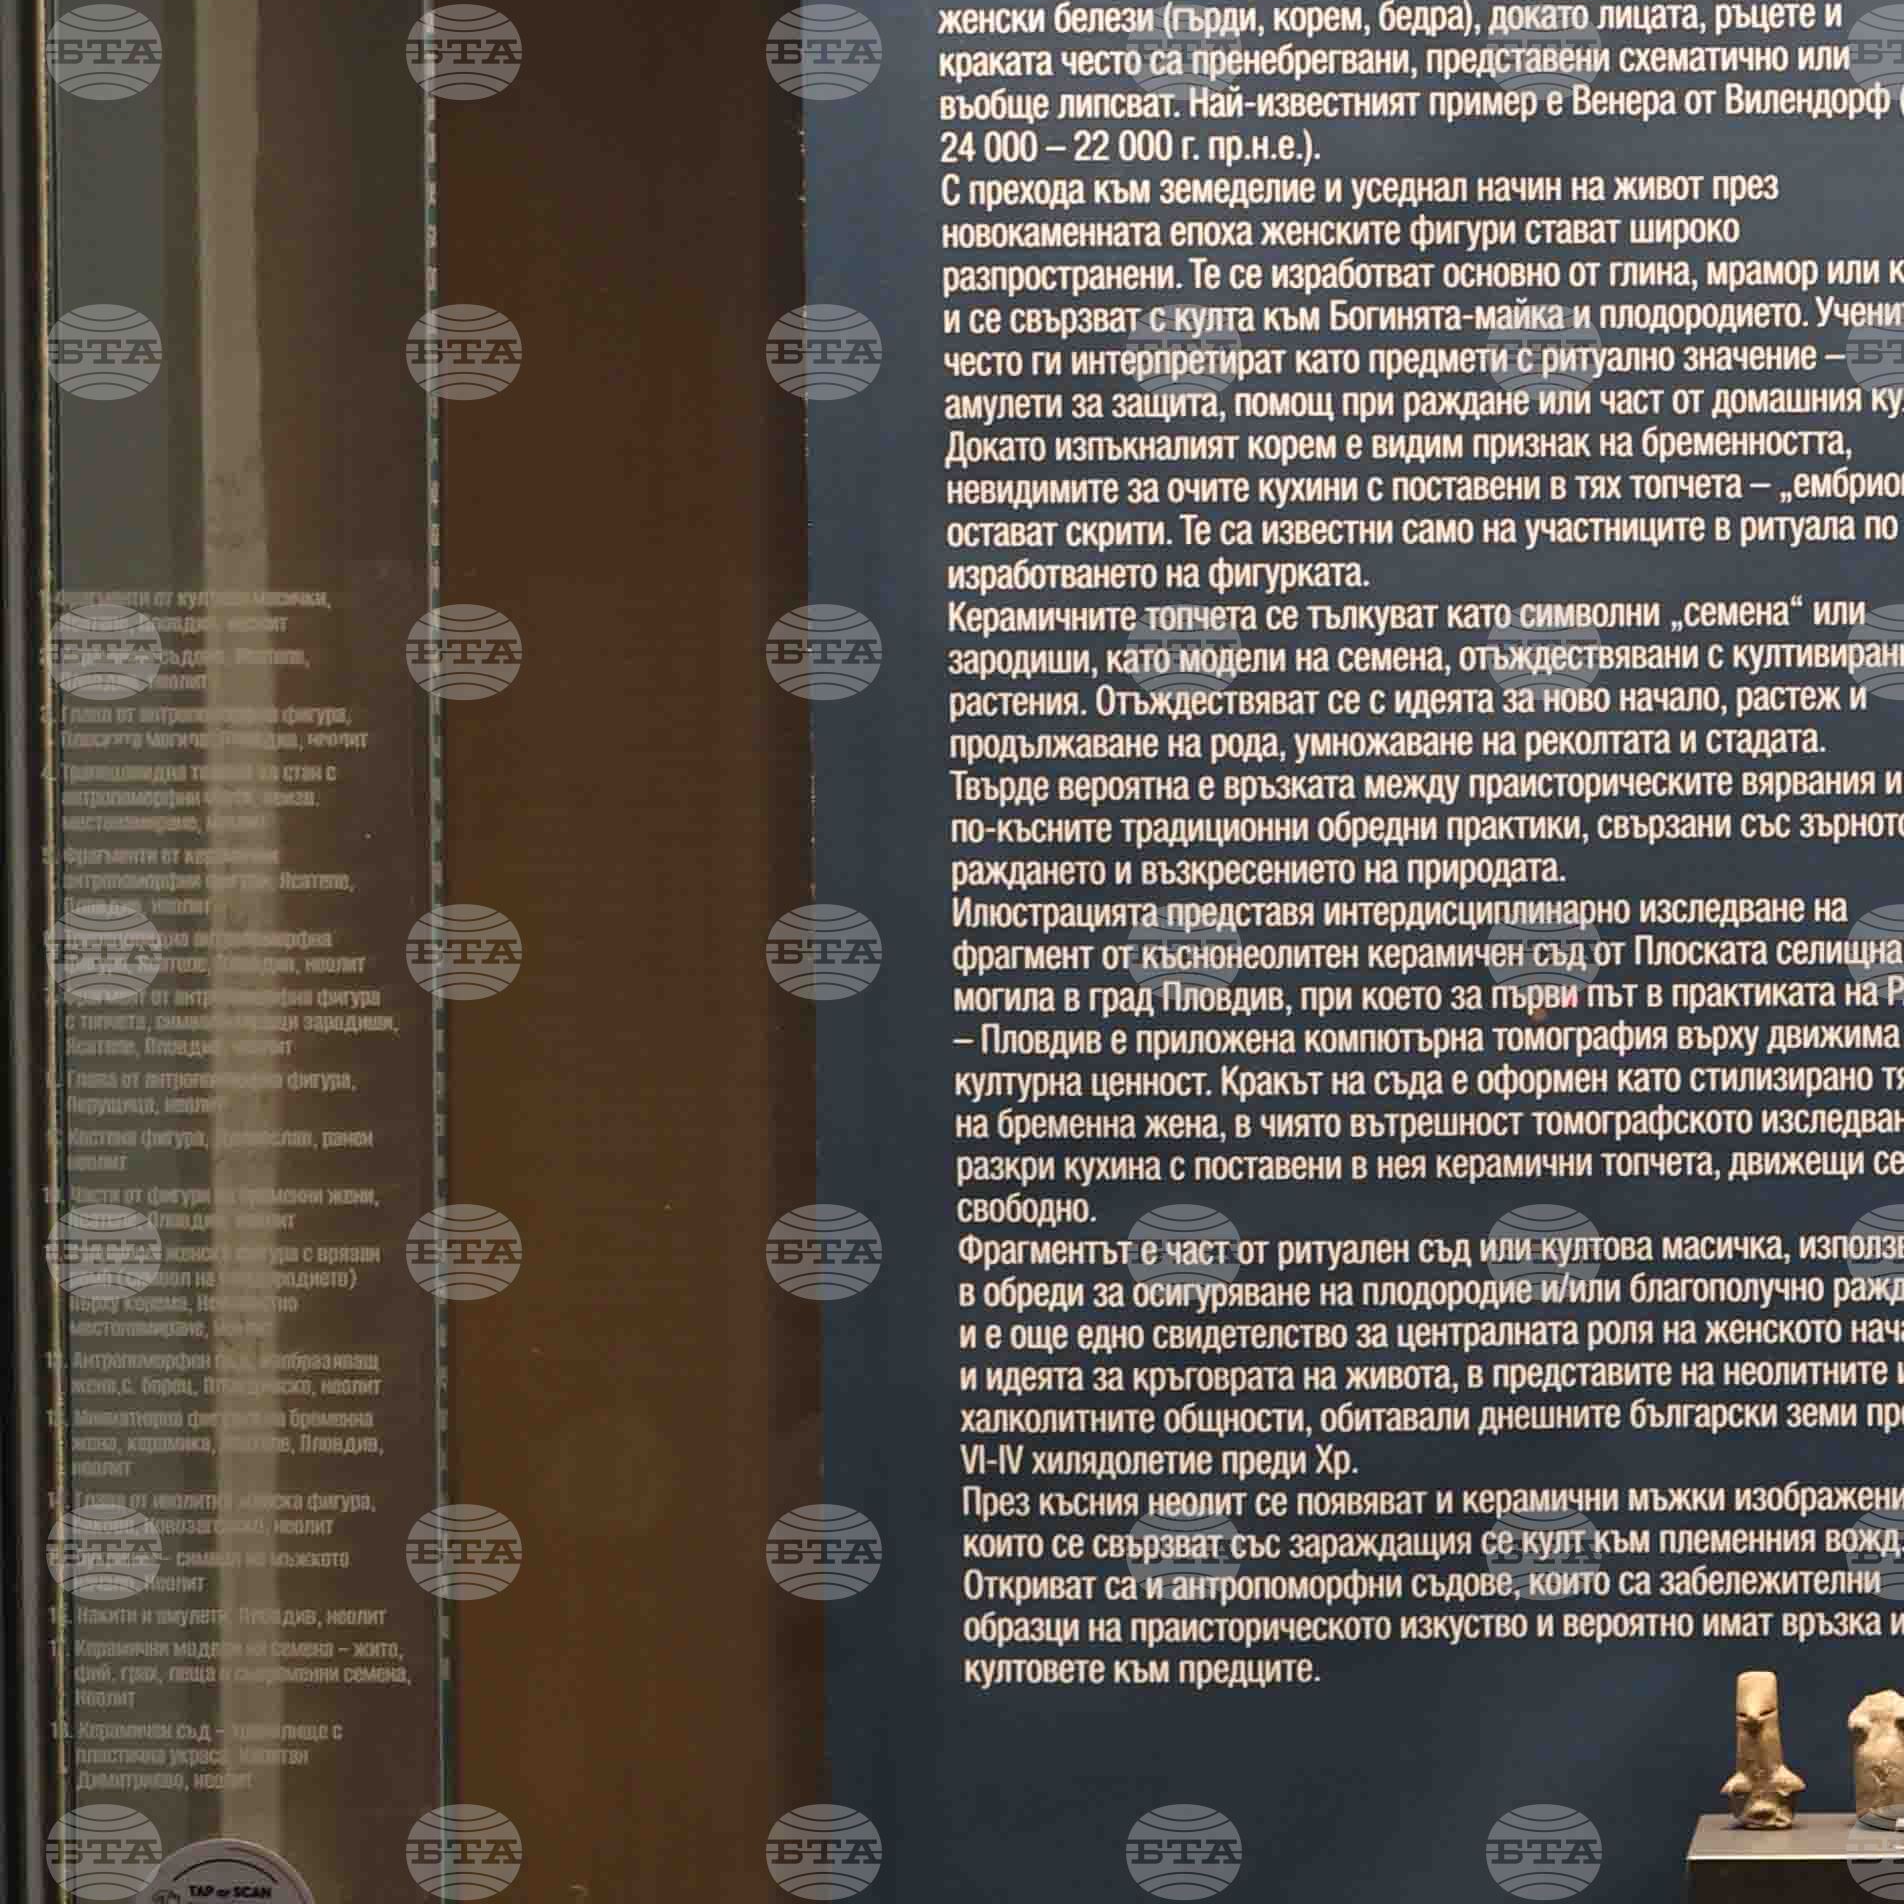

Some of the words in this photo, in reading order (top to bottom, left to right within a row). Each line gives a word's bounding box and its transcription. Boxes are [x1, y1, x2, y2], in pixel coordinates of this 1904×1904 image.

[941, 221, 1163, 249] новокаменната
[1169, 220, 1254, 247] епоха
[1260, 219, 1401, 247] женските
[1409, 213, 1517, 253] фигури
[1524, 218, 1622, 245] стават
[1629, 217, 1741, 251] широко
[959, 1443, 1025, 1475] VI-IV
[1031, 1450, 1214, 1481] хилядолетие
[1221, 1449, 1307, 1482] преди
[1315, 1443, 1359, 1481] Хр.
[964, 1658, 1106, 1691] култовете
[1113, 1659, 1170, 1684] към
[1178, 1657, 1321, 1691] предците.
[188, 1885, 215, 1897] TAP
[233, 1885, 271, 1898] SCAN
